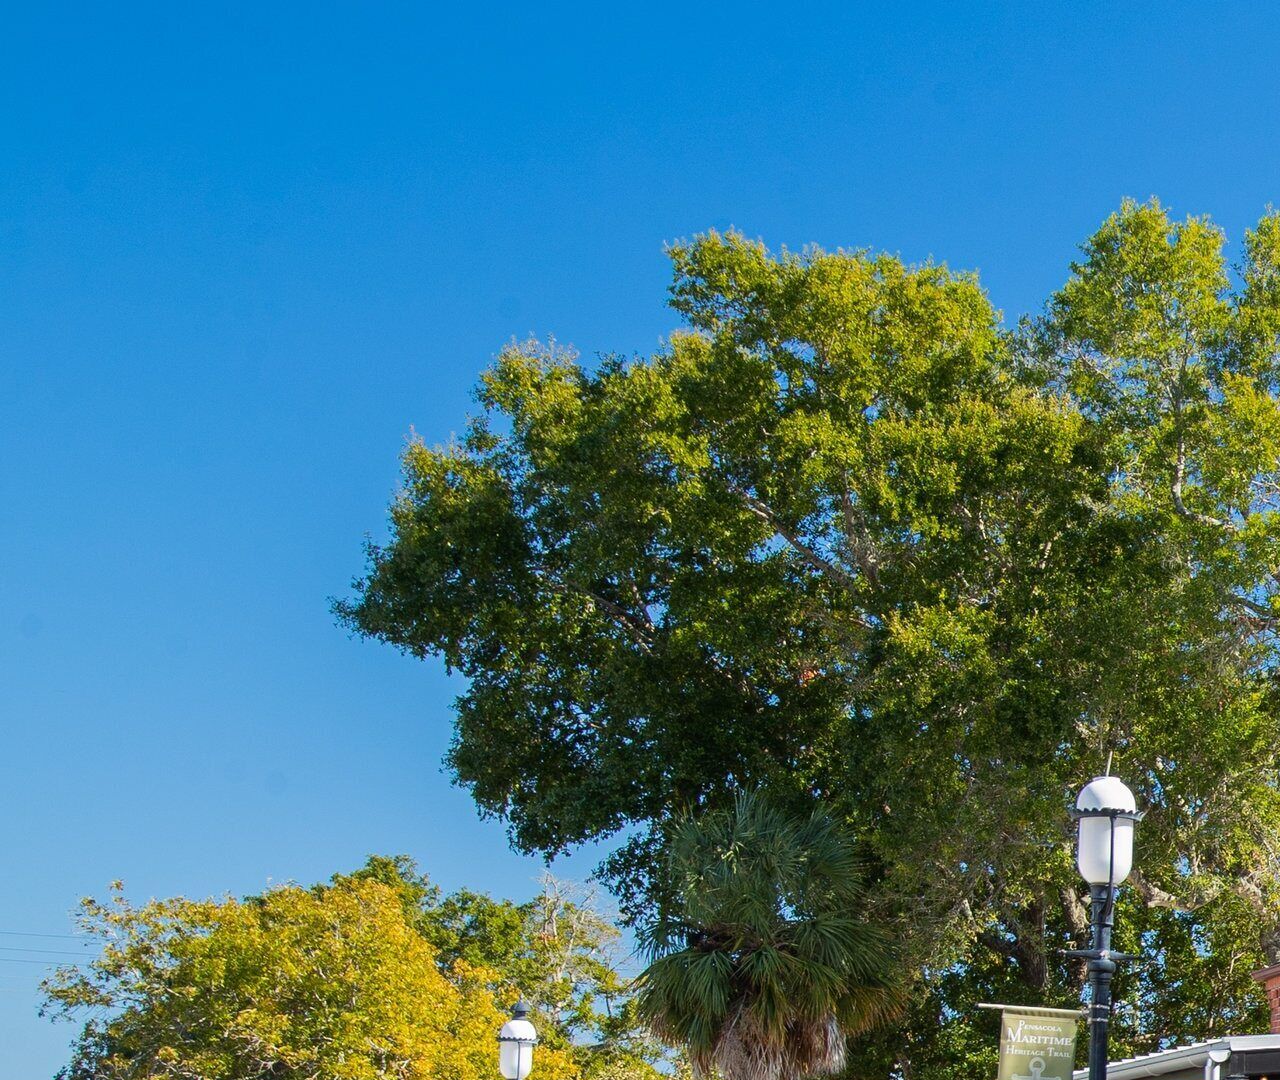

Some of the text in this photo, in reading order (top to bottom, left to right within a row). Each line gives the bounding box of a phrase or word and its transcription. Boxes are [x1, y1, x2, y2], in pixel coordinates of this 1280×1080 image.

[1019, 1020, 1062, 1032] PENSACOLA
[1007, 1027, 1072, 1046] MARITIME
[1006, 1044, 1070, 1058] HERITAGE TRAIL
